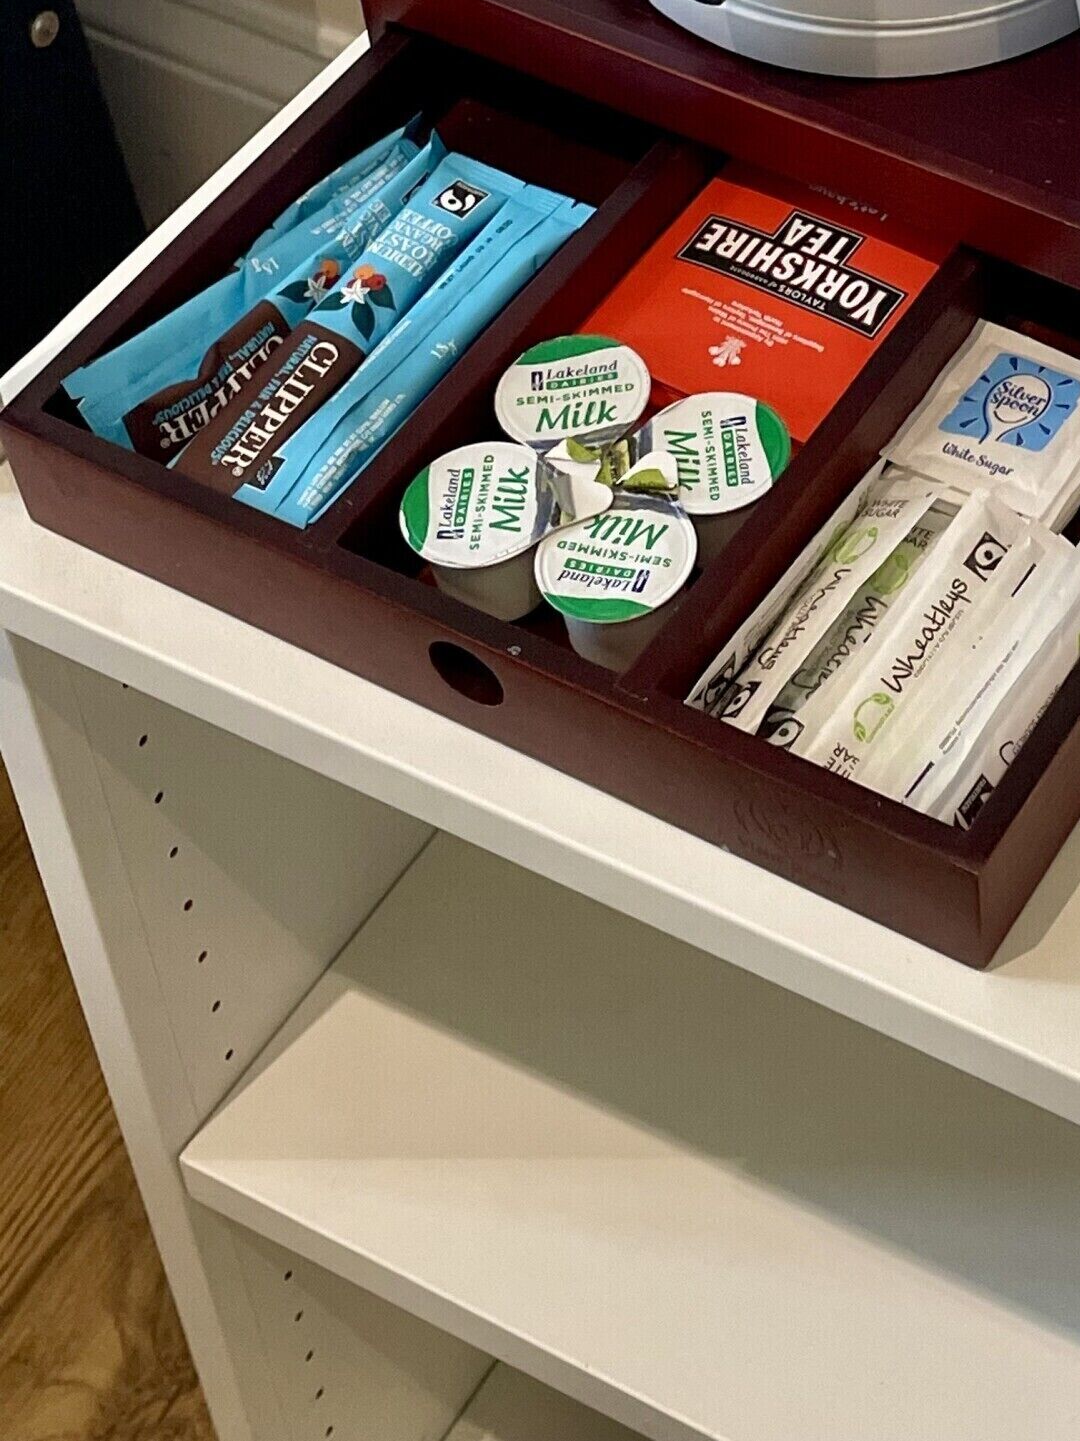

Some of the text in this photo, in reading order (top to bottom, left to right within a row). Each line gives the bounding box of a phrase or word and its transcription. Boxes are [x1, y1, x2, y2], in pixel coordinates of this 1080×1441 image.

[781, 218, 850, 266] TEA
[695, 222, 888, 326] YORKSHIRE
[778, 284, 827, 311] TAYLORS
[276, 334, 318, 380] NATURAL,
[546, 360, 618, 382] Lakeland
[221, 341, 340, 470] CLIPPER
[253, 393, 265, 408] &
[261, 375, 283, 400] FAIR
[516, 383, 635, 406] SEMI-SKIMMED
[1000, 381, 1047, 406] Silver
[536, 400, 618, 432] Milk
[664, 430, 701, 491] Milk
[701, 410, 720, 502] SEMI-SKIMMED
[724, 430, 739, 487] DAIRIES
[734, 426, 754, 486] Lakeland
[942, 441, 1014, 476] White Sugar
[439, 468, 461, 529] Lakeland
[454, 468, 474, 527] DAIRIES
[469, 454, 494, 550] SEMI-SKIMMED
[489, 465, 530, 533] Milk
[557, 540, 672, 568] SEMI-SKIMMED
[584, 514, 669, 551] Milk
[556, 568, 630, 594] Lakeland
[565, 558, 637, 579] DAIRIES
[881, 577, 972, 693] Wheatleys
